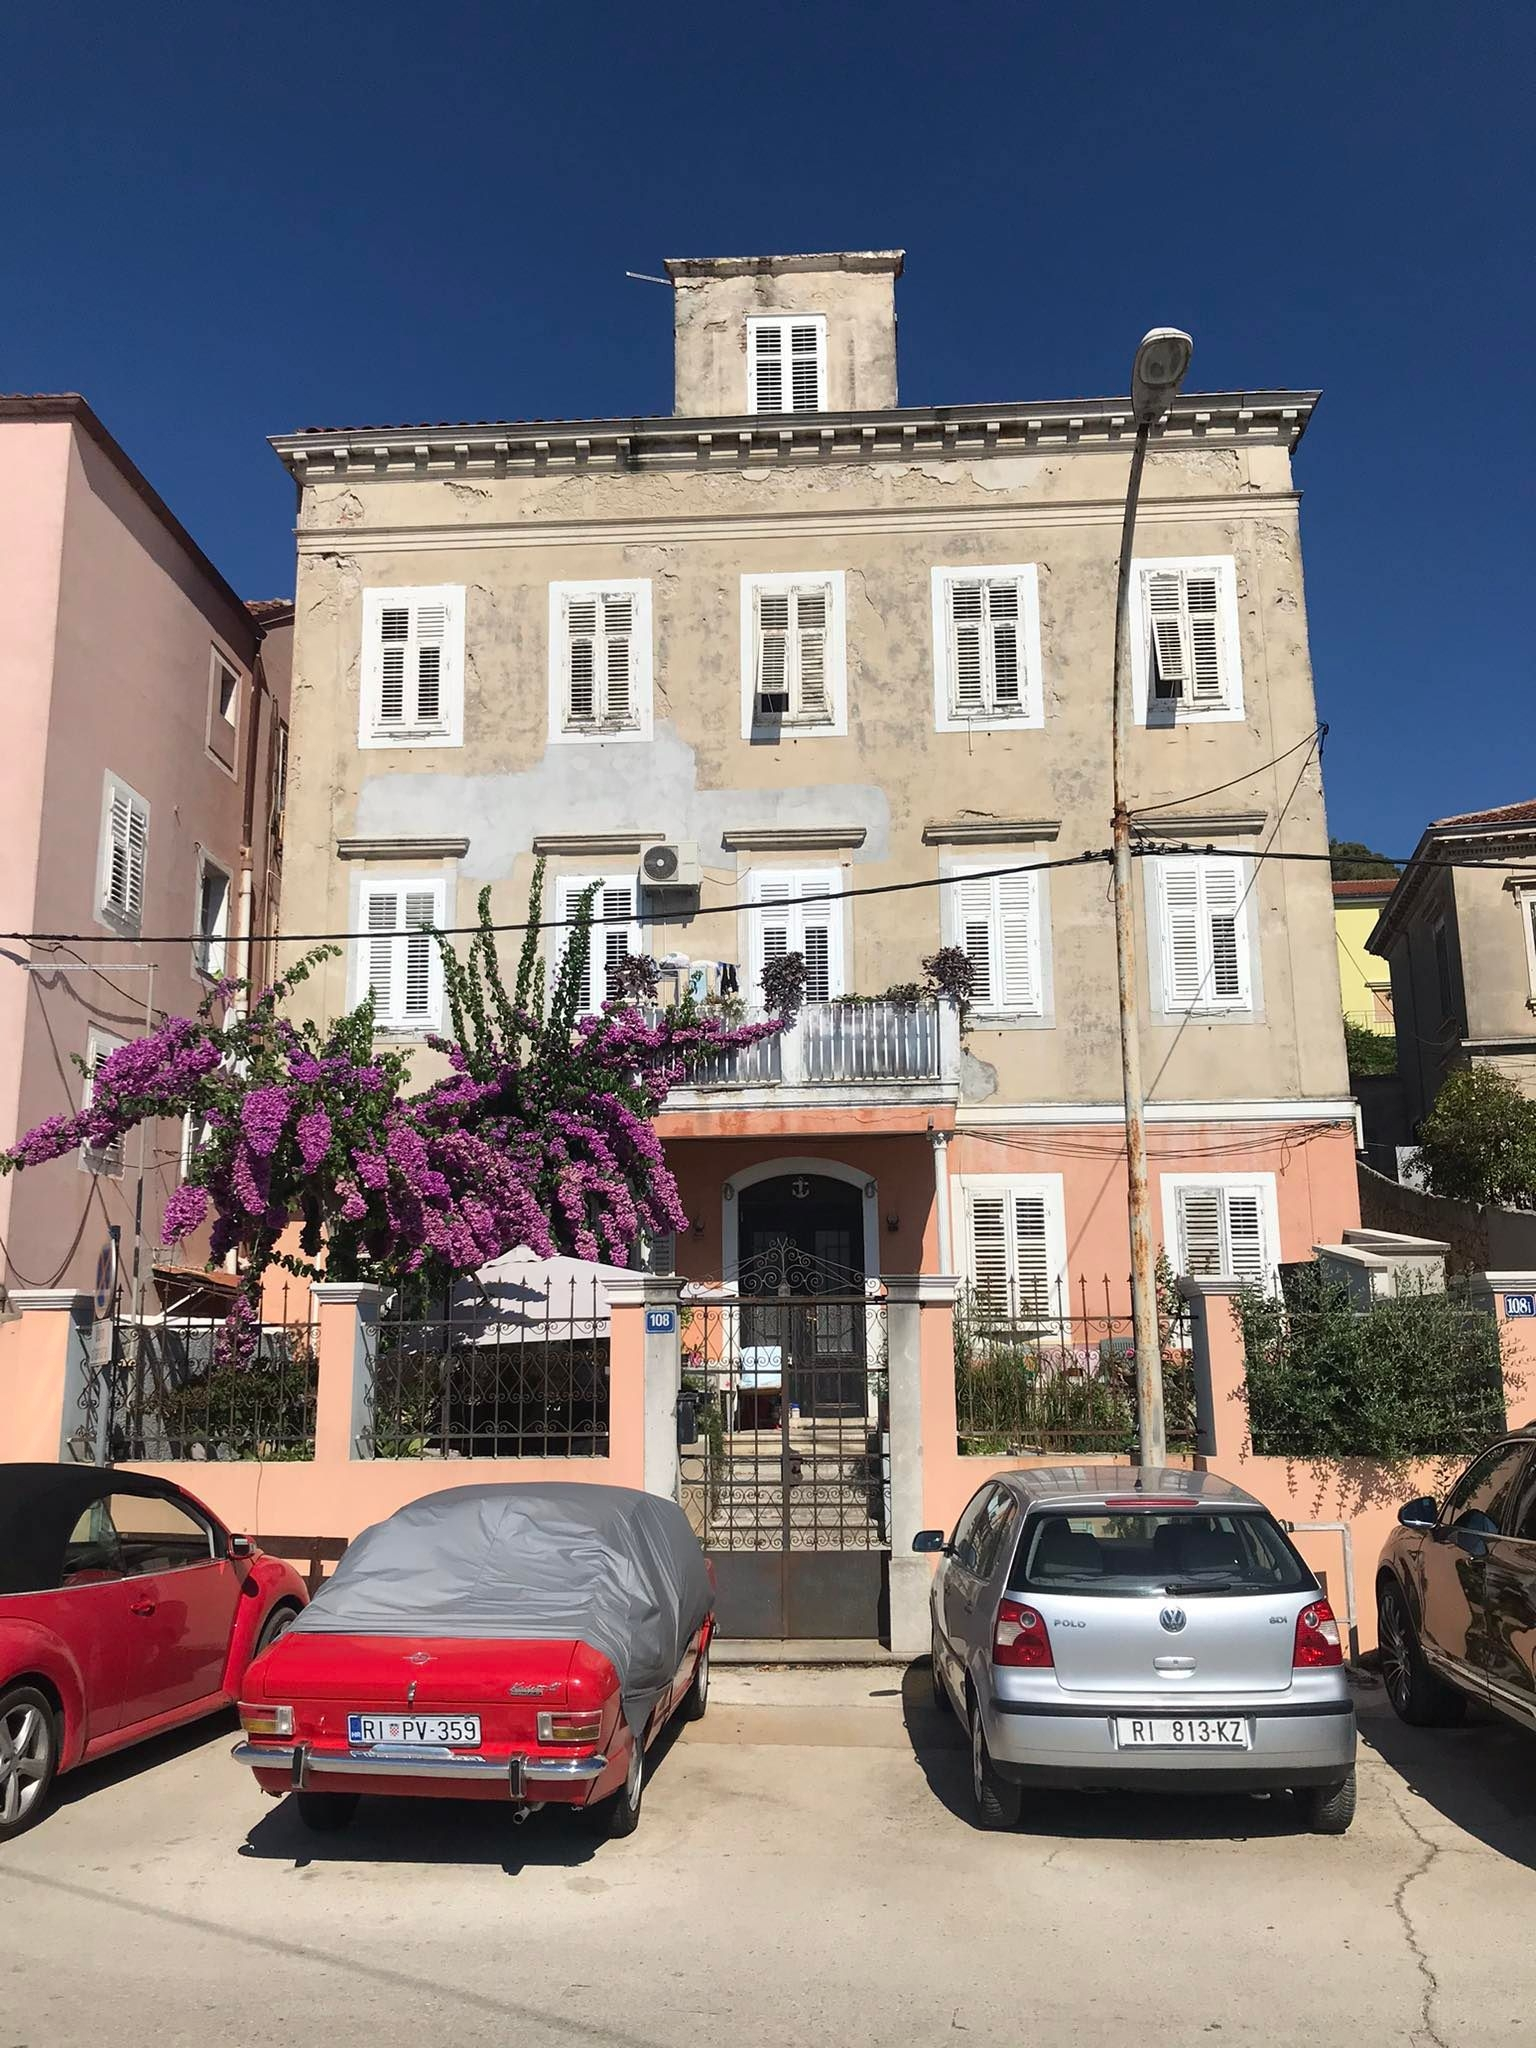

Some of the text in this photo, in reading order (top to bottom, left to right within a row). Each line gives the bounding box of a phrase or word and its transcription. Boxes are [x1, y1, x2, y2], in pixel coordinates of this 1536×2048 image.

[650, 1313, 670, 1327] 108
[1054, 1619, 1087, 1628] POLO
[363, 1720, 476, 1740] RI PV-359
[1132, 1721, 1244, 1742] RI 813-KZ
